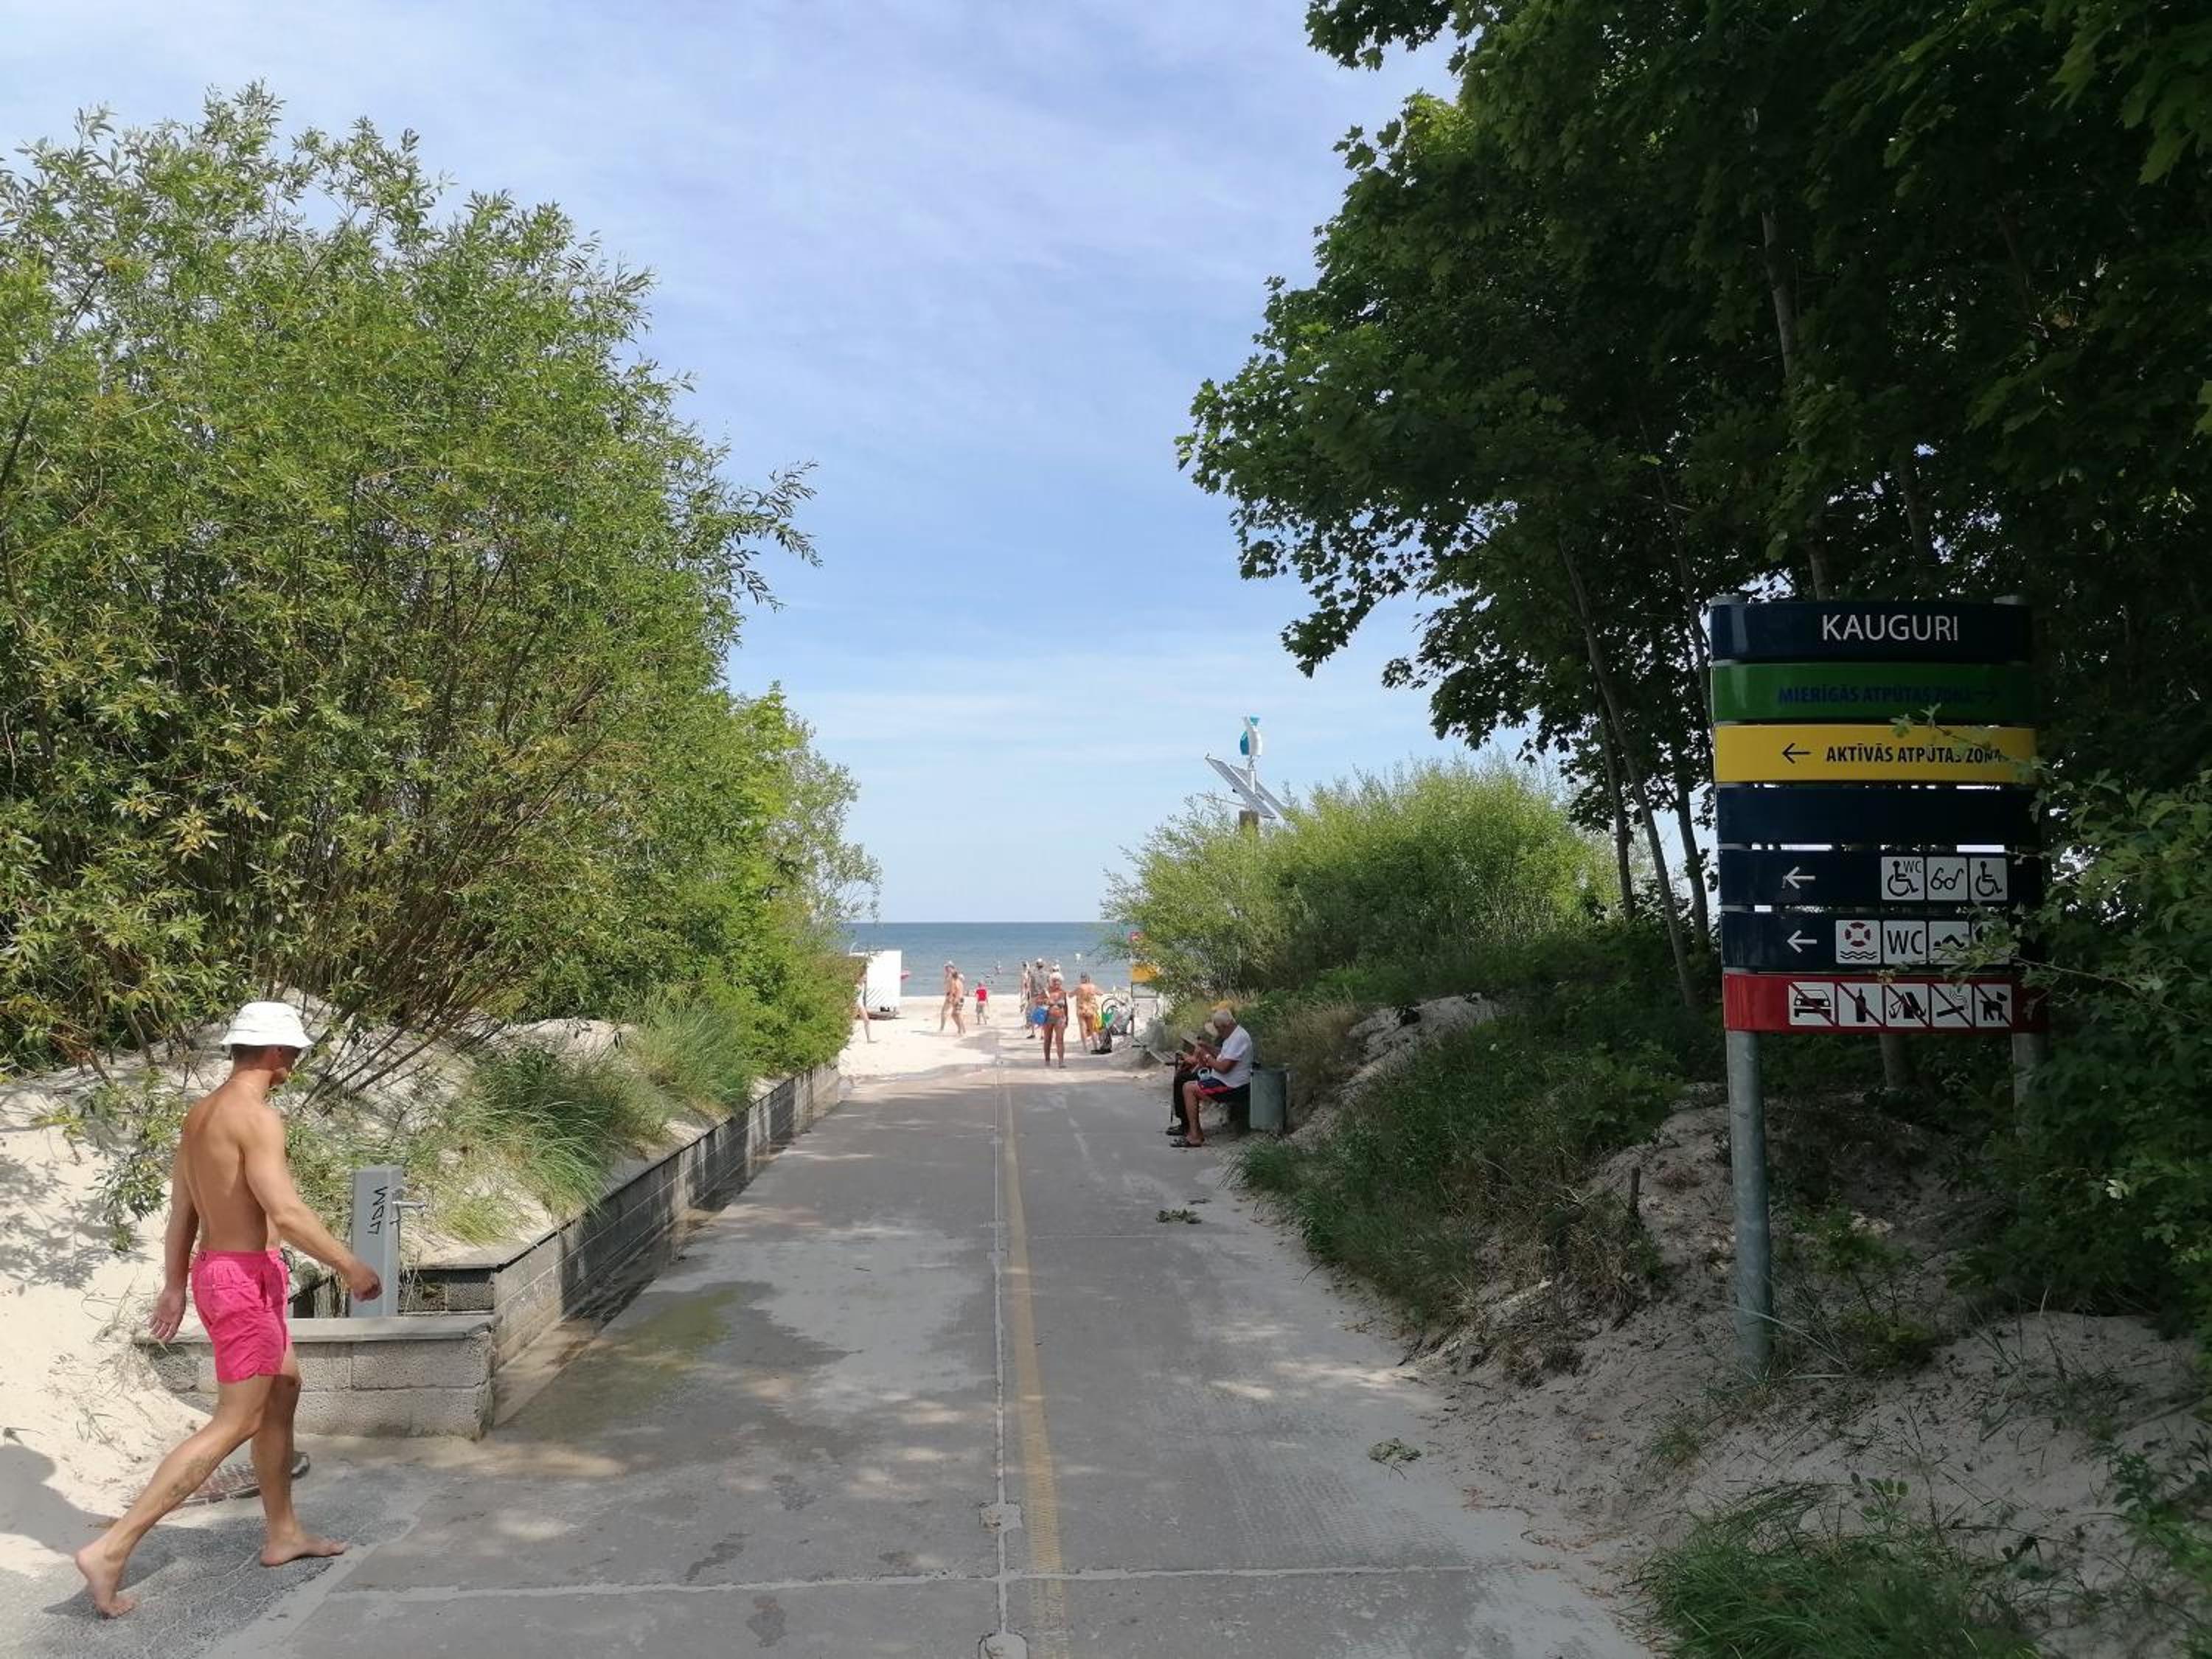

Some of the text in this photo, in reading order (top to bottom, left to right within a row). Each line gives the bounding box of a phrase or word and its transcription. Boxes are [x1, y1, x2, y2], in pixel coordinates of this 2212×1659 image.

[1821, 614, 1959, 641] KAUGURI
[1826, 742, 1893, 763] AKTĪVĀS
[1903, 860, 1922, 874] WC
[1887, 930, 1924, 955] WC
